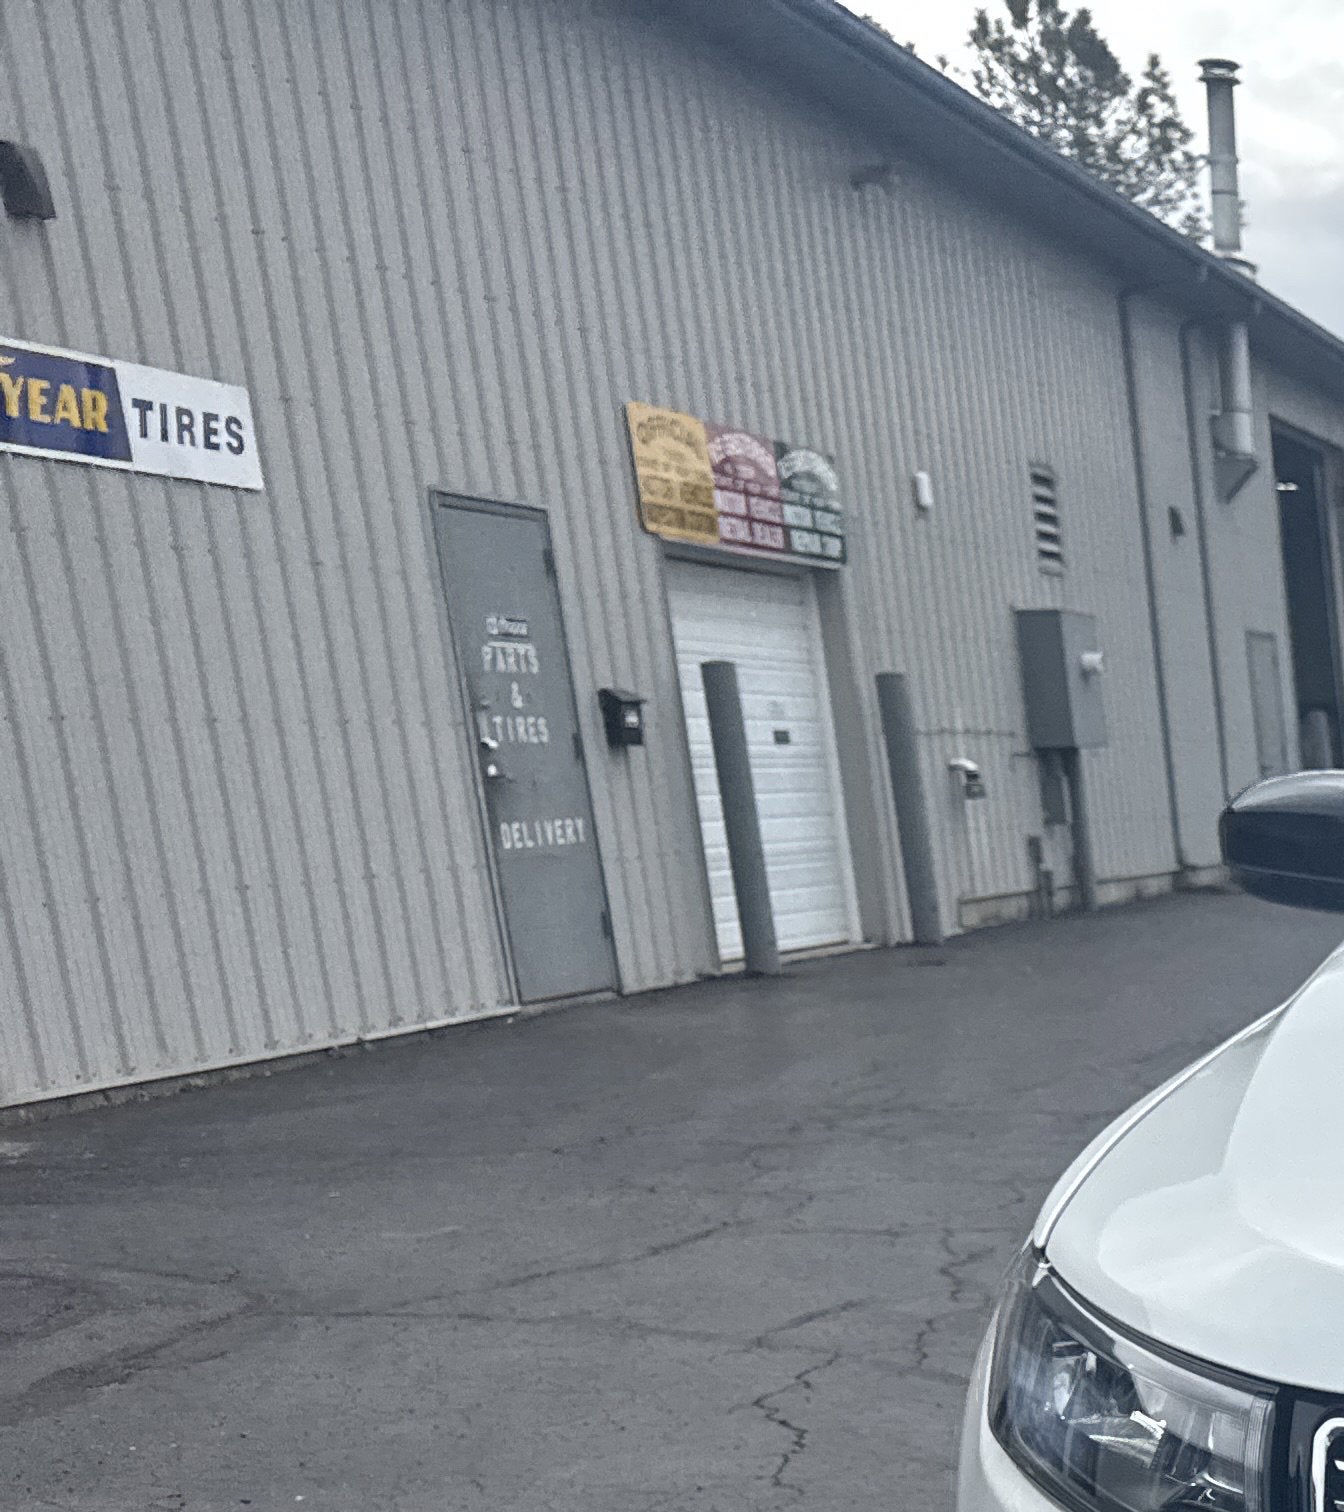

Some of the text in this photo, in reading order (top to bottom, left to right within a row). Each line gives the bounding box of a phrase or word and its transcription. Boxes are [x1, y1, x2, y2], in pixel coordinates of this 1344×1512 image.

[131, 397, 245, 455] TIRES
[481, 645, 540, 675] PARTS
[492, 715, 549, 743] TIRES
[500, 816, 586, 850] DELIVERY
